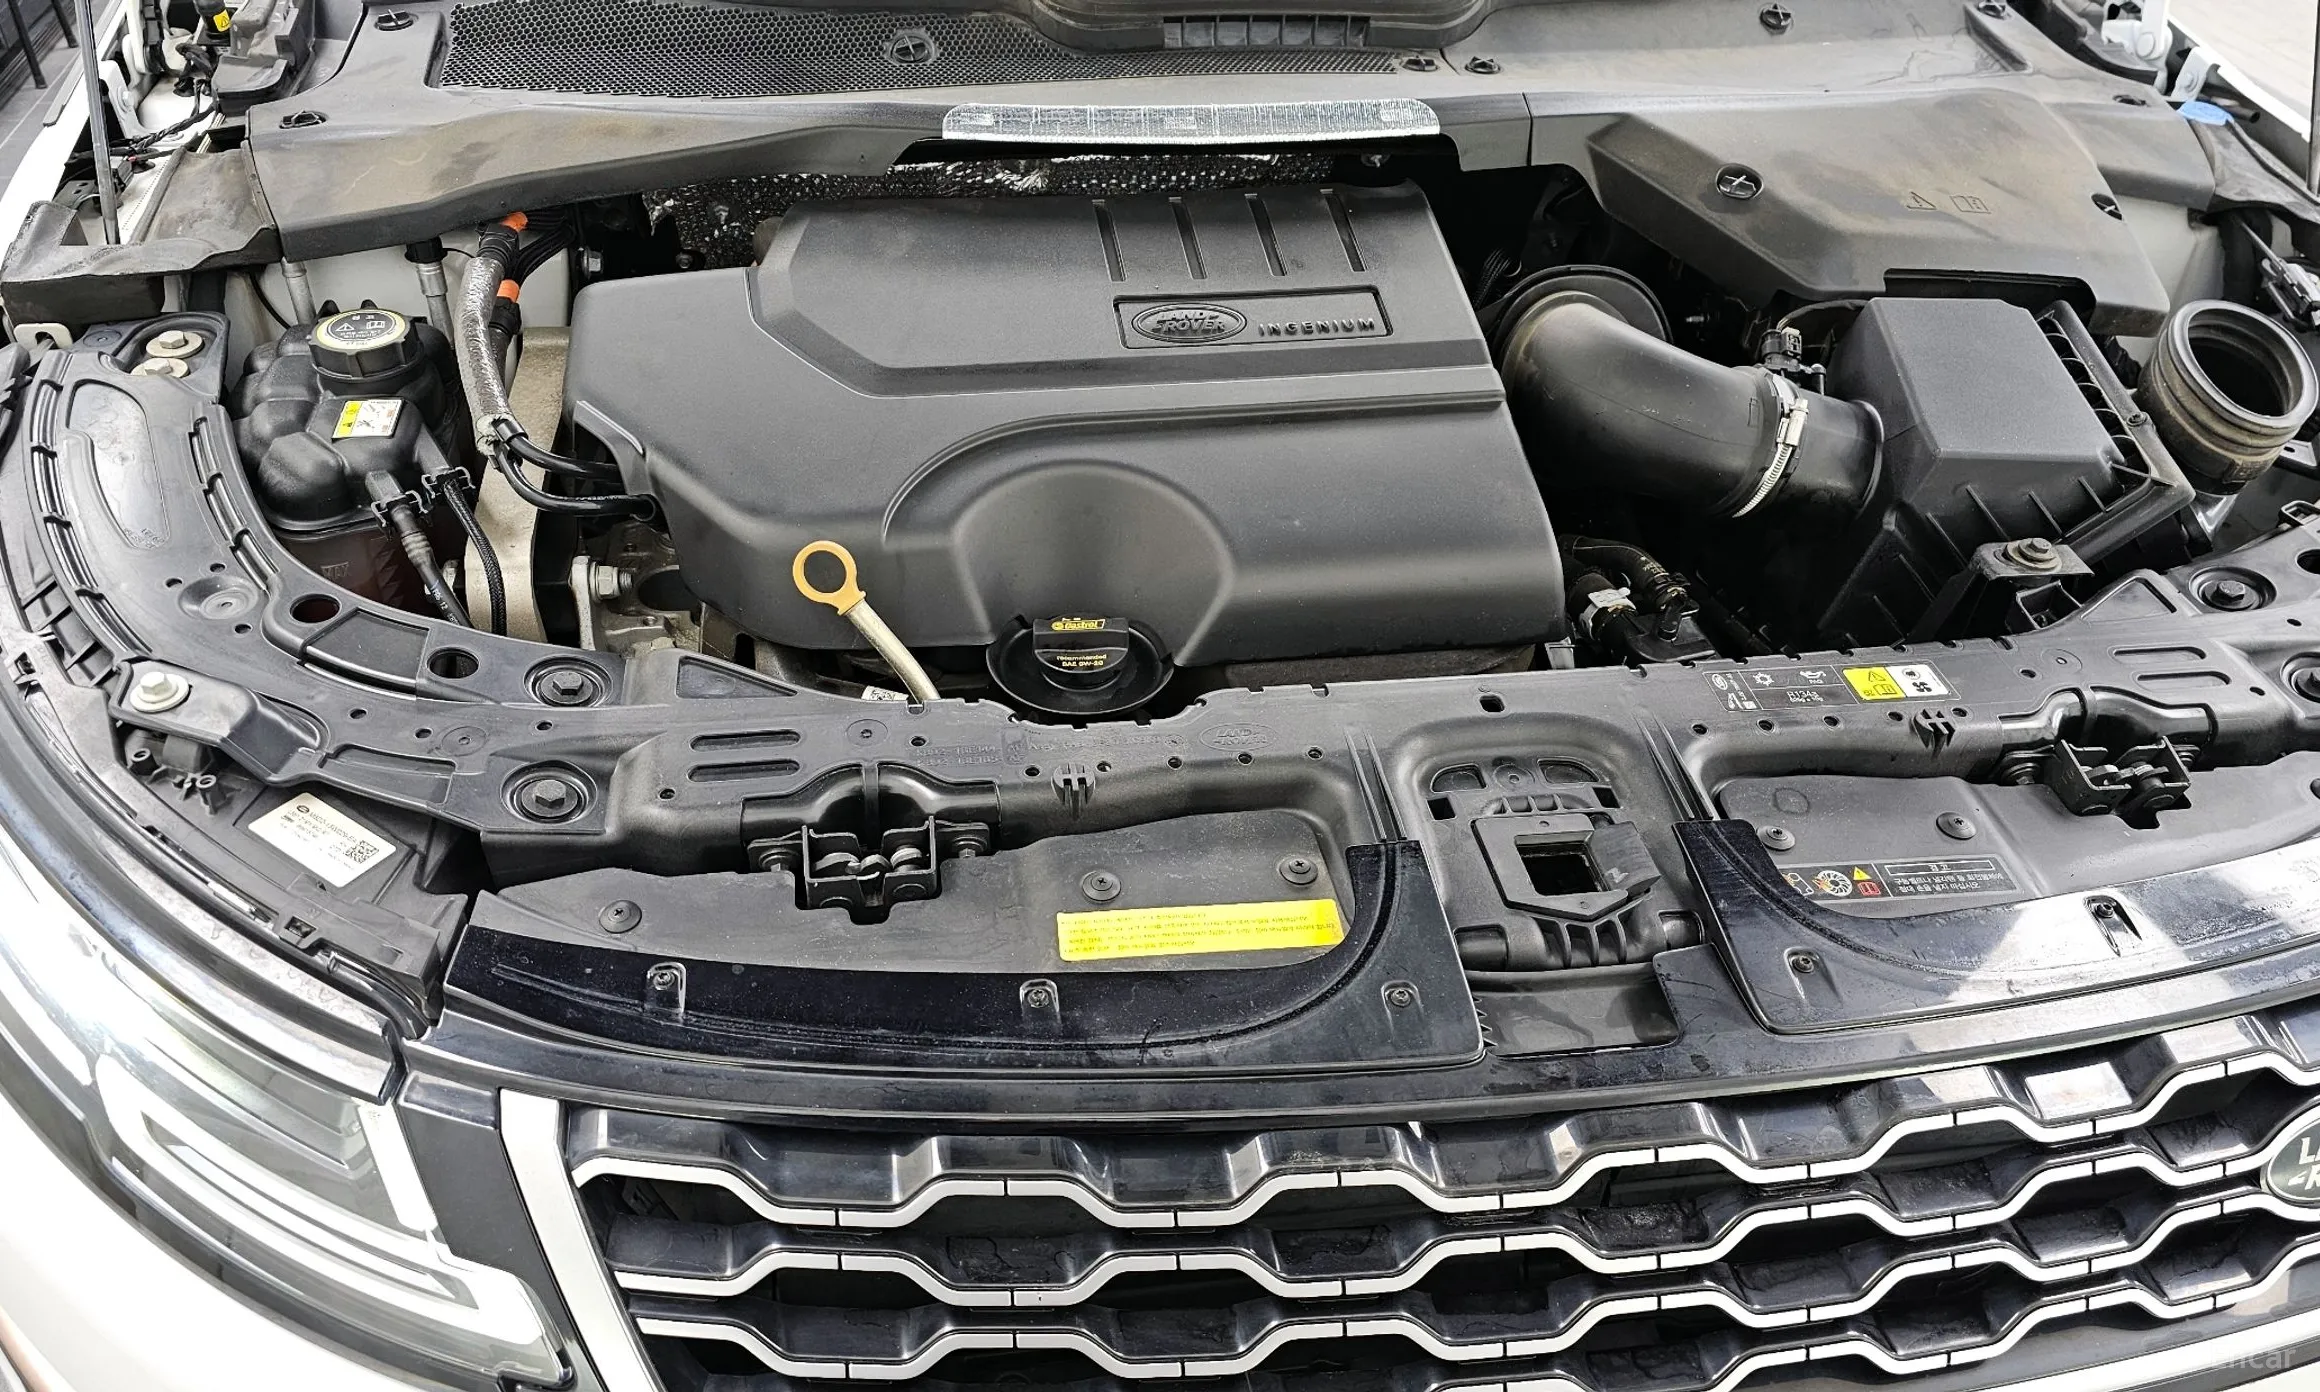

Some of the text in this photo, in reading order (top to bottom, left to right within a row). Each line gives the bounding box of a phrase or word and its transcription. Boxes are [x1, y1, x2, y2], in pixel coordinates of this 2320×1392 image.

[1164, 319, 1226, 332] ROVER
[1258, 317, 1375, 337] INGENIUM
[1064, 620, 1098, 630] Castrol
